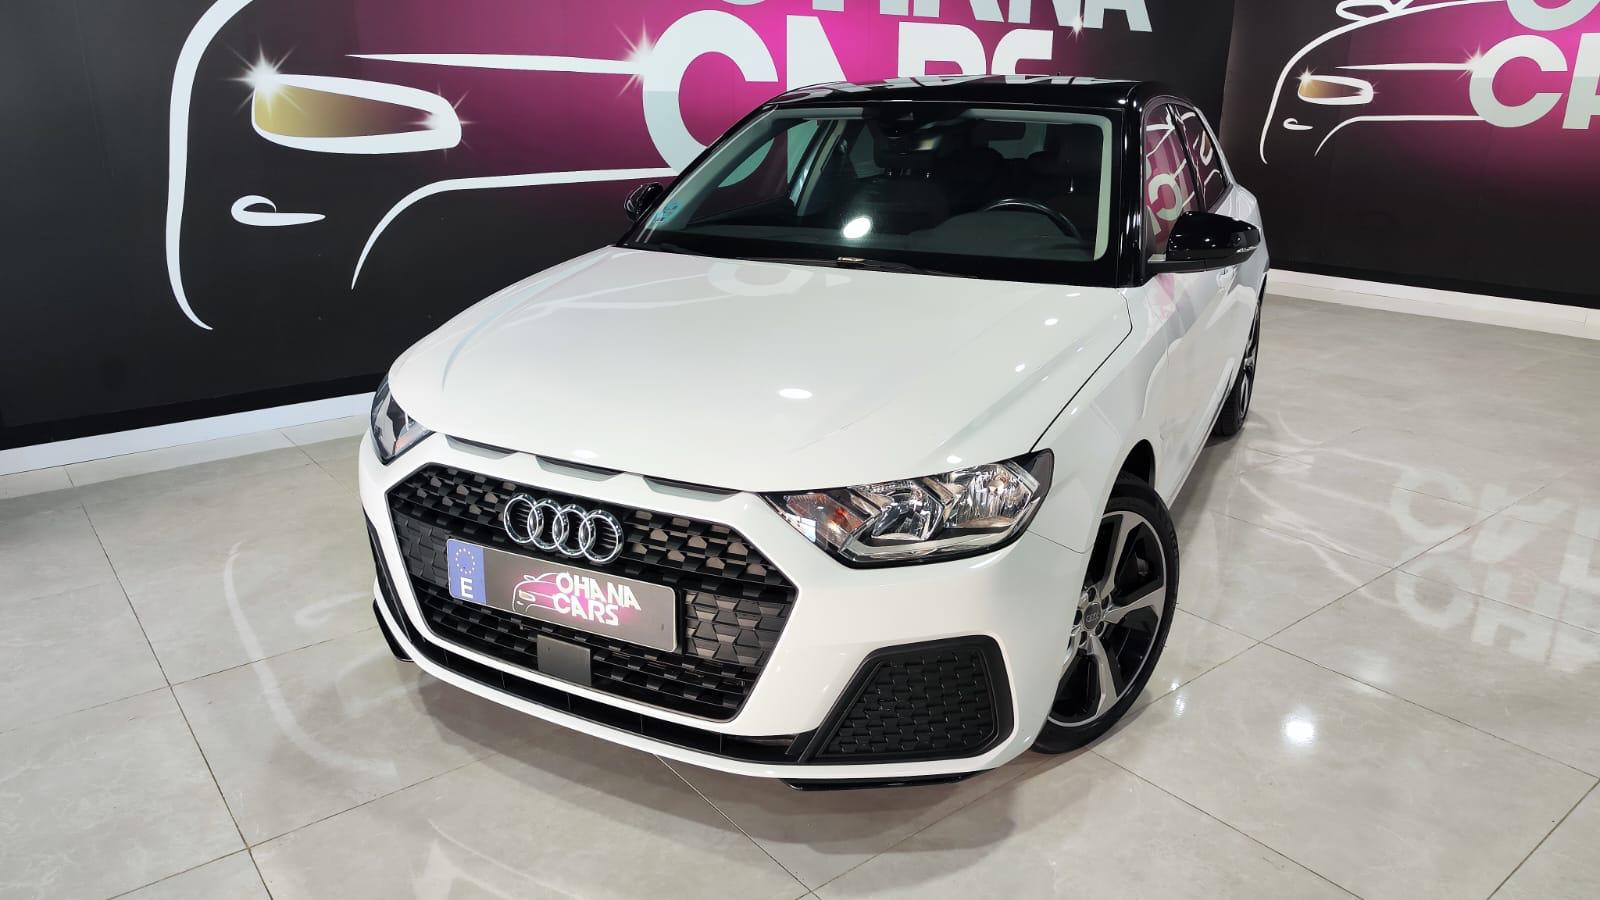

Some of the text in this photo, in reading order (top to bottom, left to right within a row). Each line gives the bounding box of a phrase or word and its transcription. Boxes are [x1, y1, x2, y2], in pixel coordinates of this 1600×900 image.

[460, 577, 474, 598] E
[555, 571, 641, 611] OHANA
[553, 593, 619, 626] CARS
